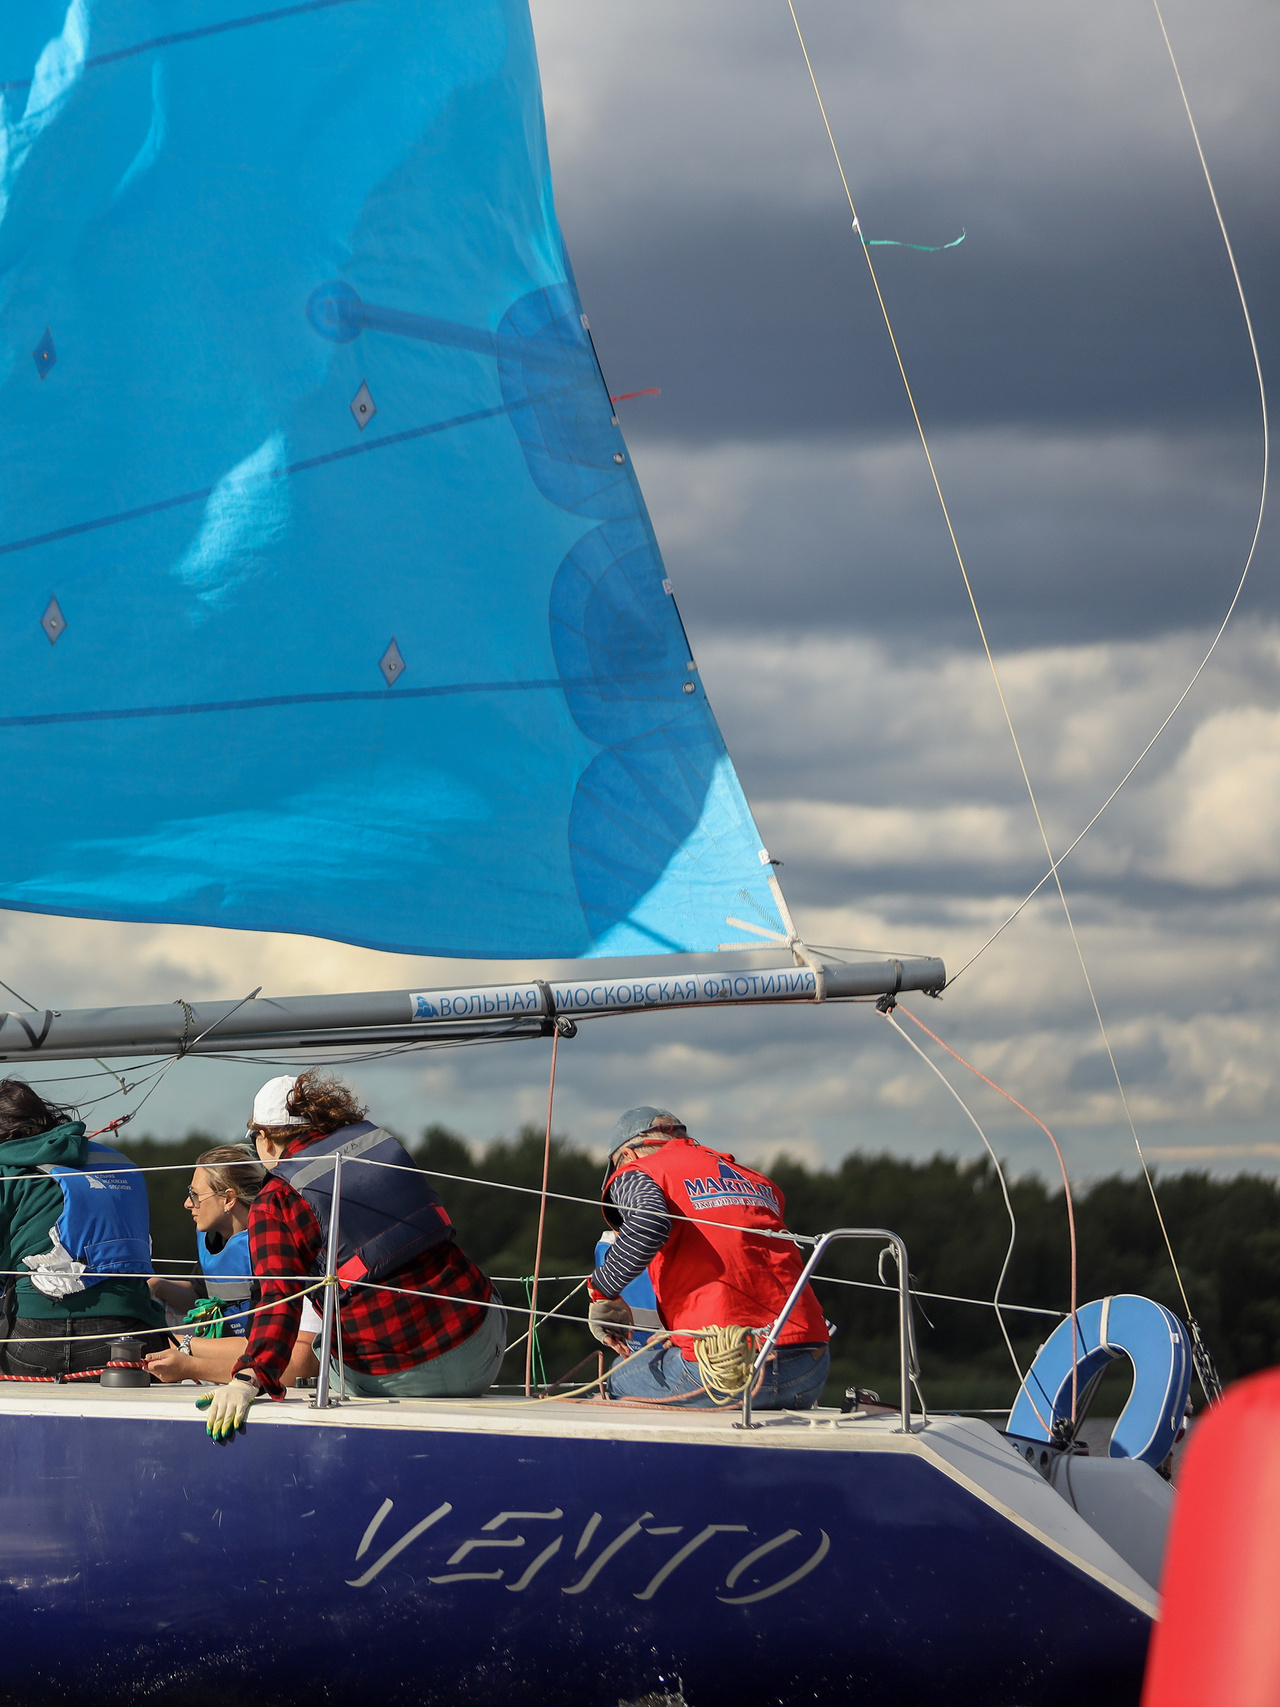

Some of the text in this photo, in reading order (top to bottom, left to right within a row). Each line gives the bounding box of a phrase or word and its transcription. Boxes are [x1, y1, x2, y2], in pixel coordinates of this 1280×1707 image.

[439, 971, 816, 1017] ВОЛЬНАЯ МОСКОВСКАЯ ФЛОТИЛИЯ
[344, 1497, 831, 1605] VENTO
